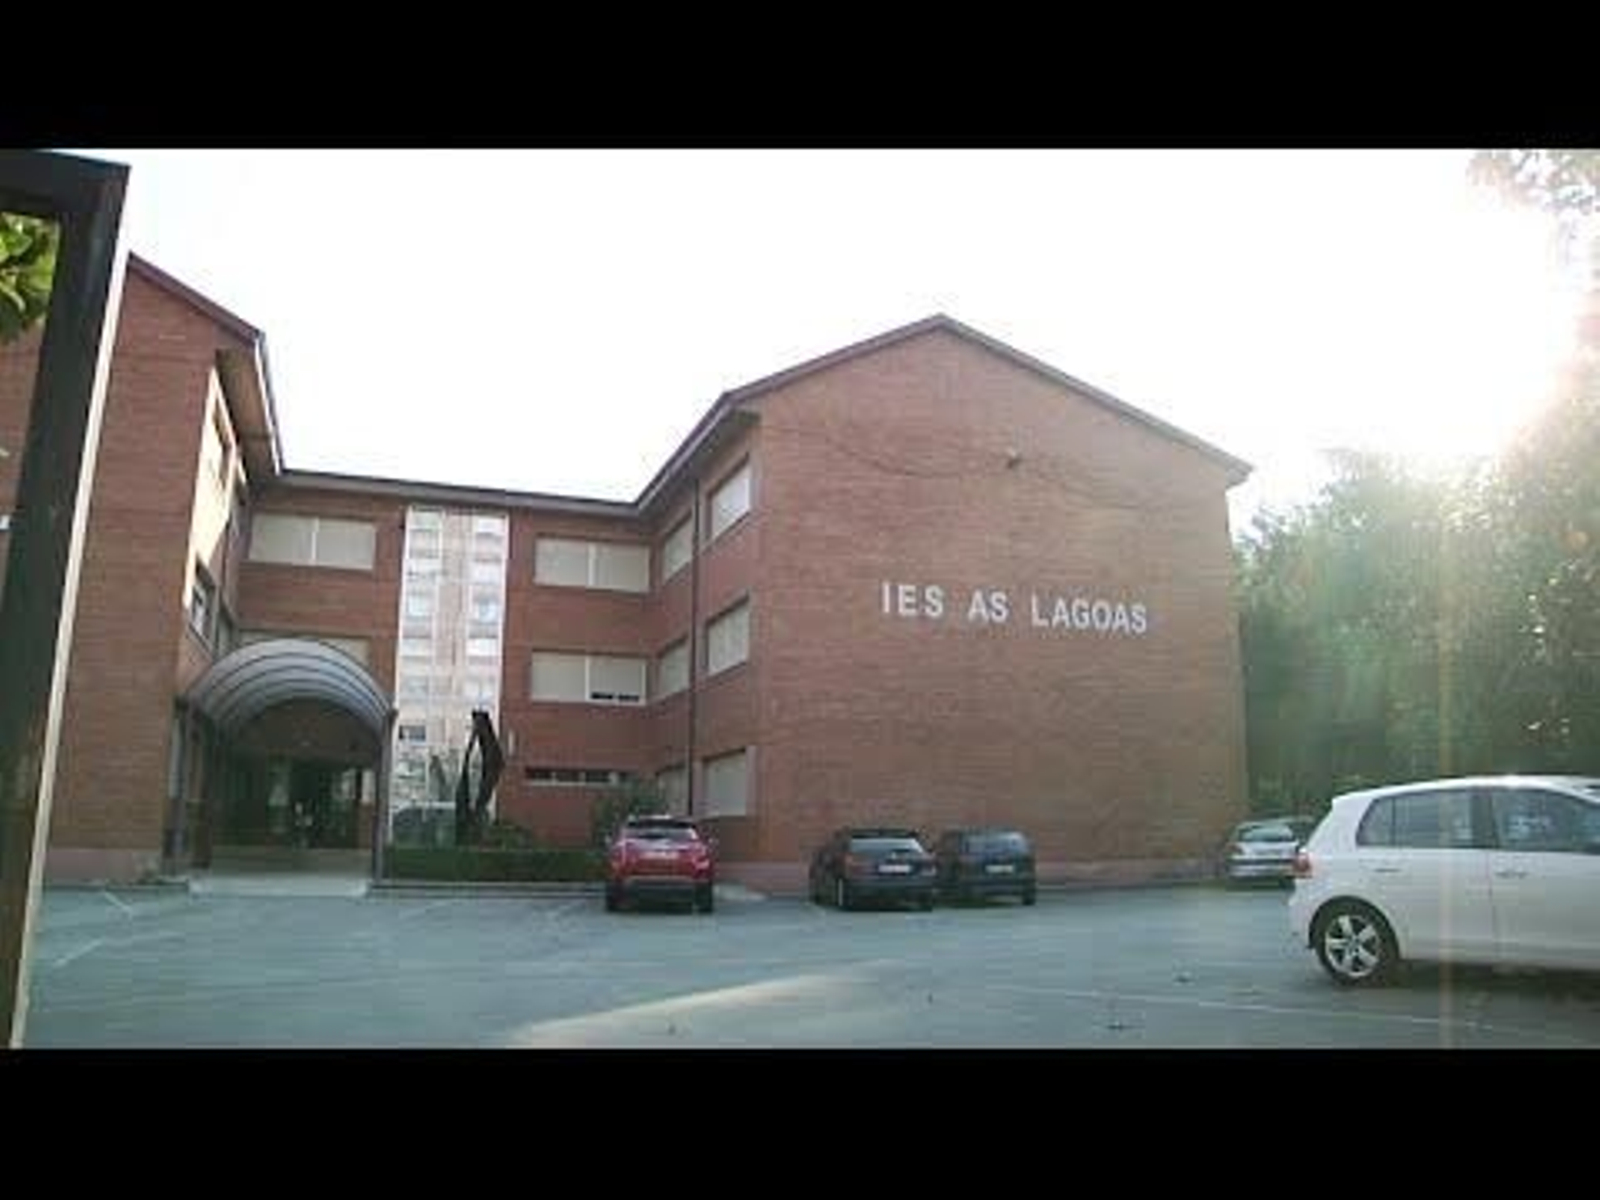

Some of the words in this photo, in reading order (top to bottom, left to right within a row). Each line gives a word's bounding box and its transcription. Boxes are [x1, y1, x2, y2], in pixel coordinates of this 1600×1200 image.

[882, 581, 945, 618] IES
[967, 588, 1010, 624] AS
[1030, 592, 1148, 635] LAGOAS
